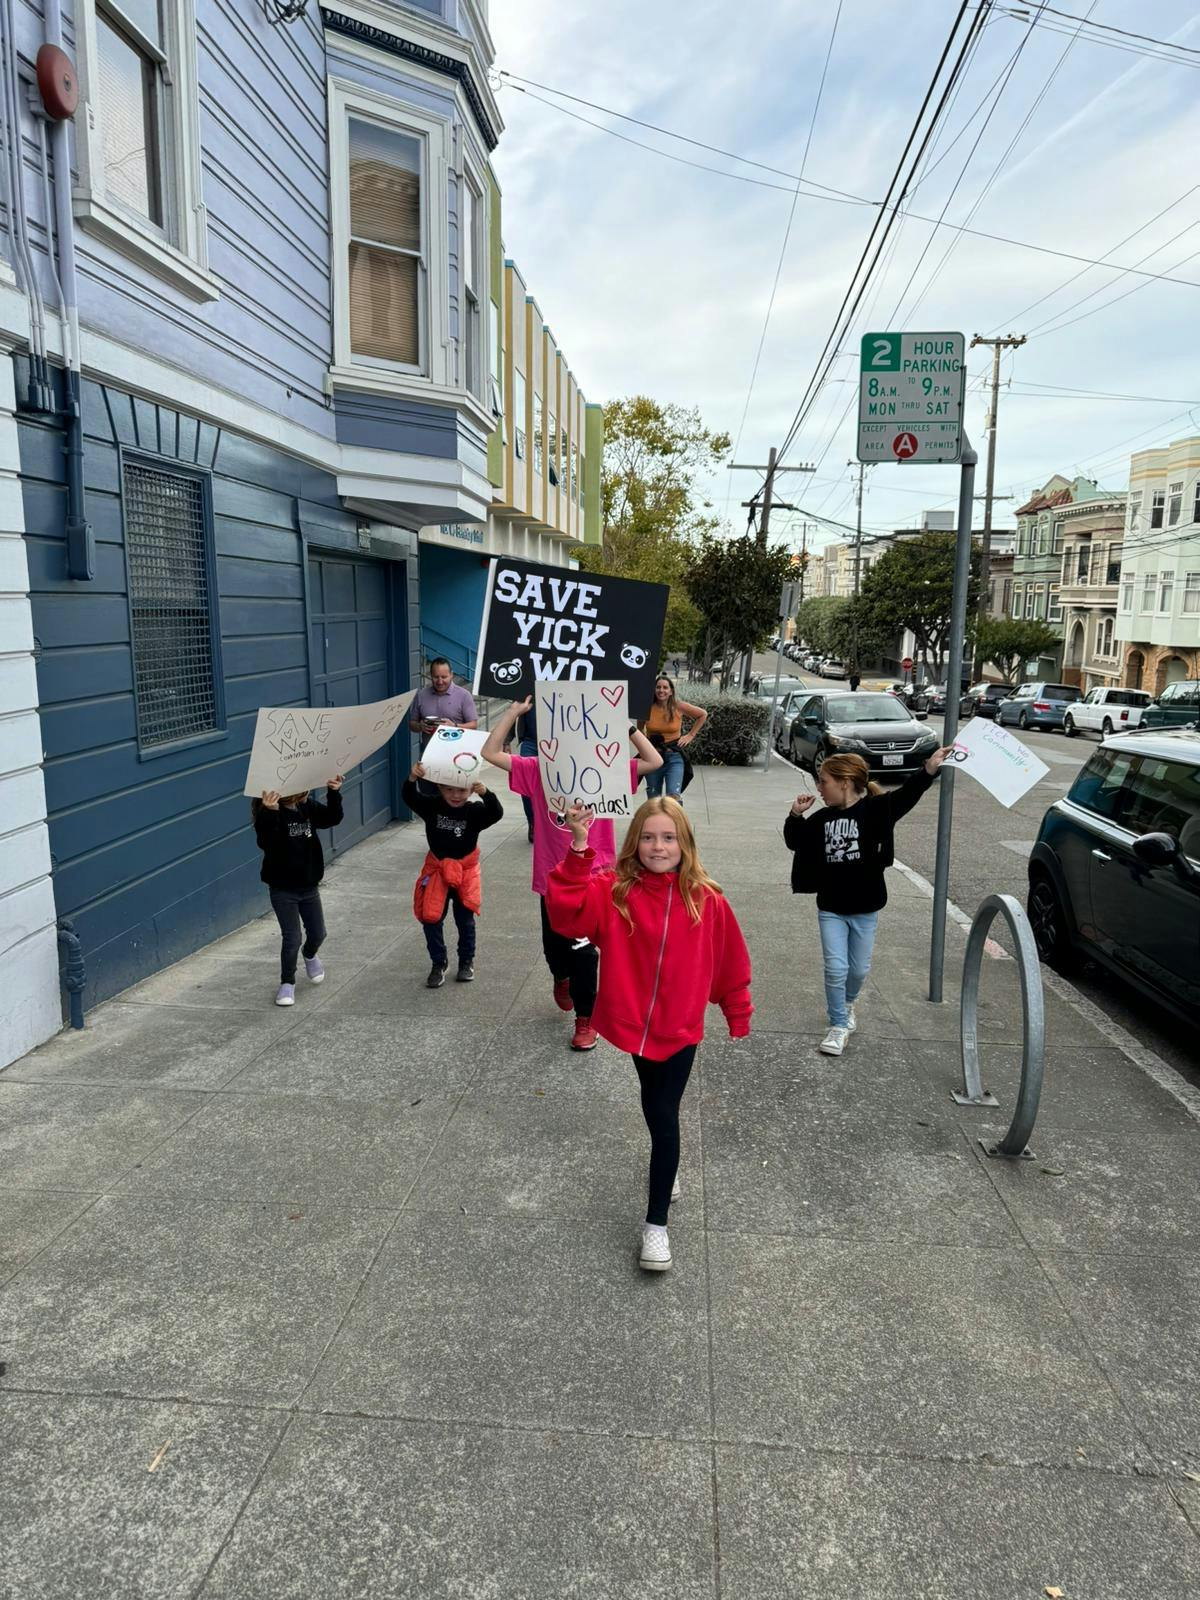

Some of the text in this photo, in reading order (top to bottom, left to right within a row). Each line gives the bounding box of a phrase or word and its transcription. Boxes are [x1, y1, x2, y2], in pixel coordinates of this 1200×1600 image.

[871, 339, 955, 366] 2 HOUR
[903, 359, 960, 373] PARKING
[868, 378, 879, 397] 8
[880, 386, 900, 397] A.M.
[921, 377, 933, 396] 9
[933, 386, 953, 397] P.M.
[868, 402, 896, 416] MON
[926, 402, 950, 415] SAT
[864, 434, 954, 453] AREA A PERMITS
[494, 569, 602, 618] SAVE
[512, 611, 610, 658] YICK
[529, 652, 594, 681] WO
[264, 709, 333, 739] SAVE
[573, 794, 630, 815] ndas!
[824, 818, 859, 840] PANDAS
[846, 851, 861, 861] WO
